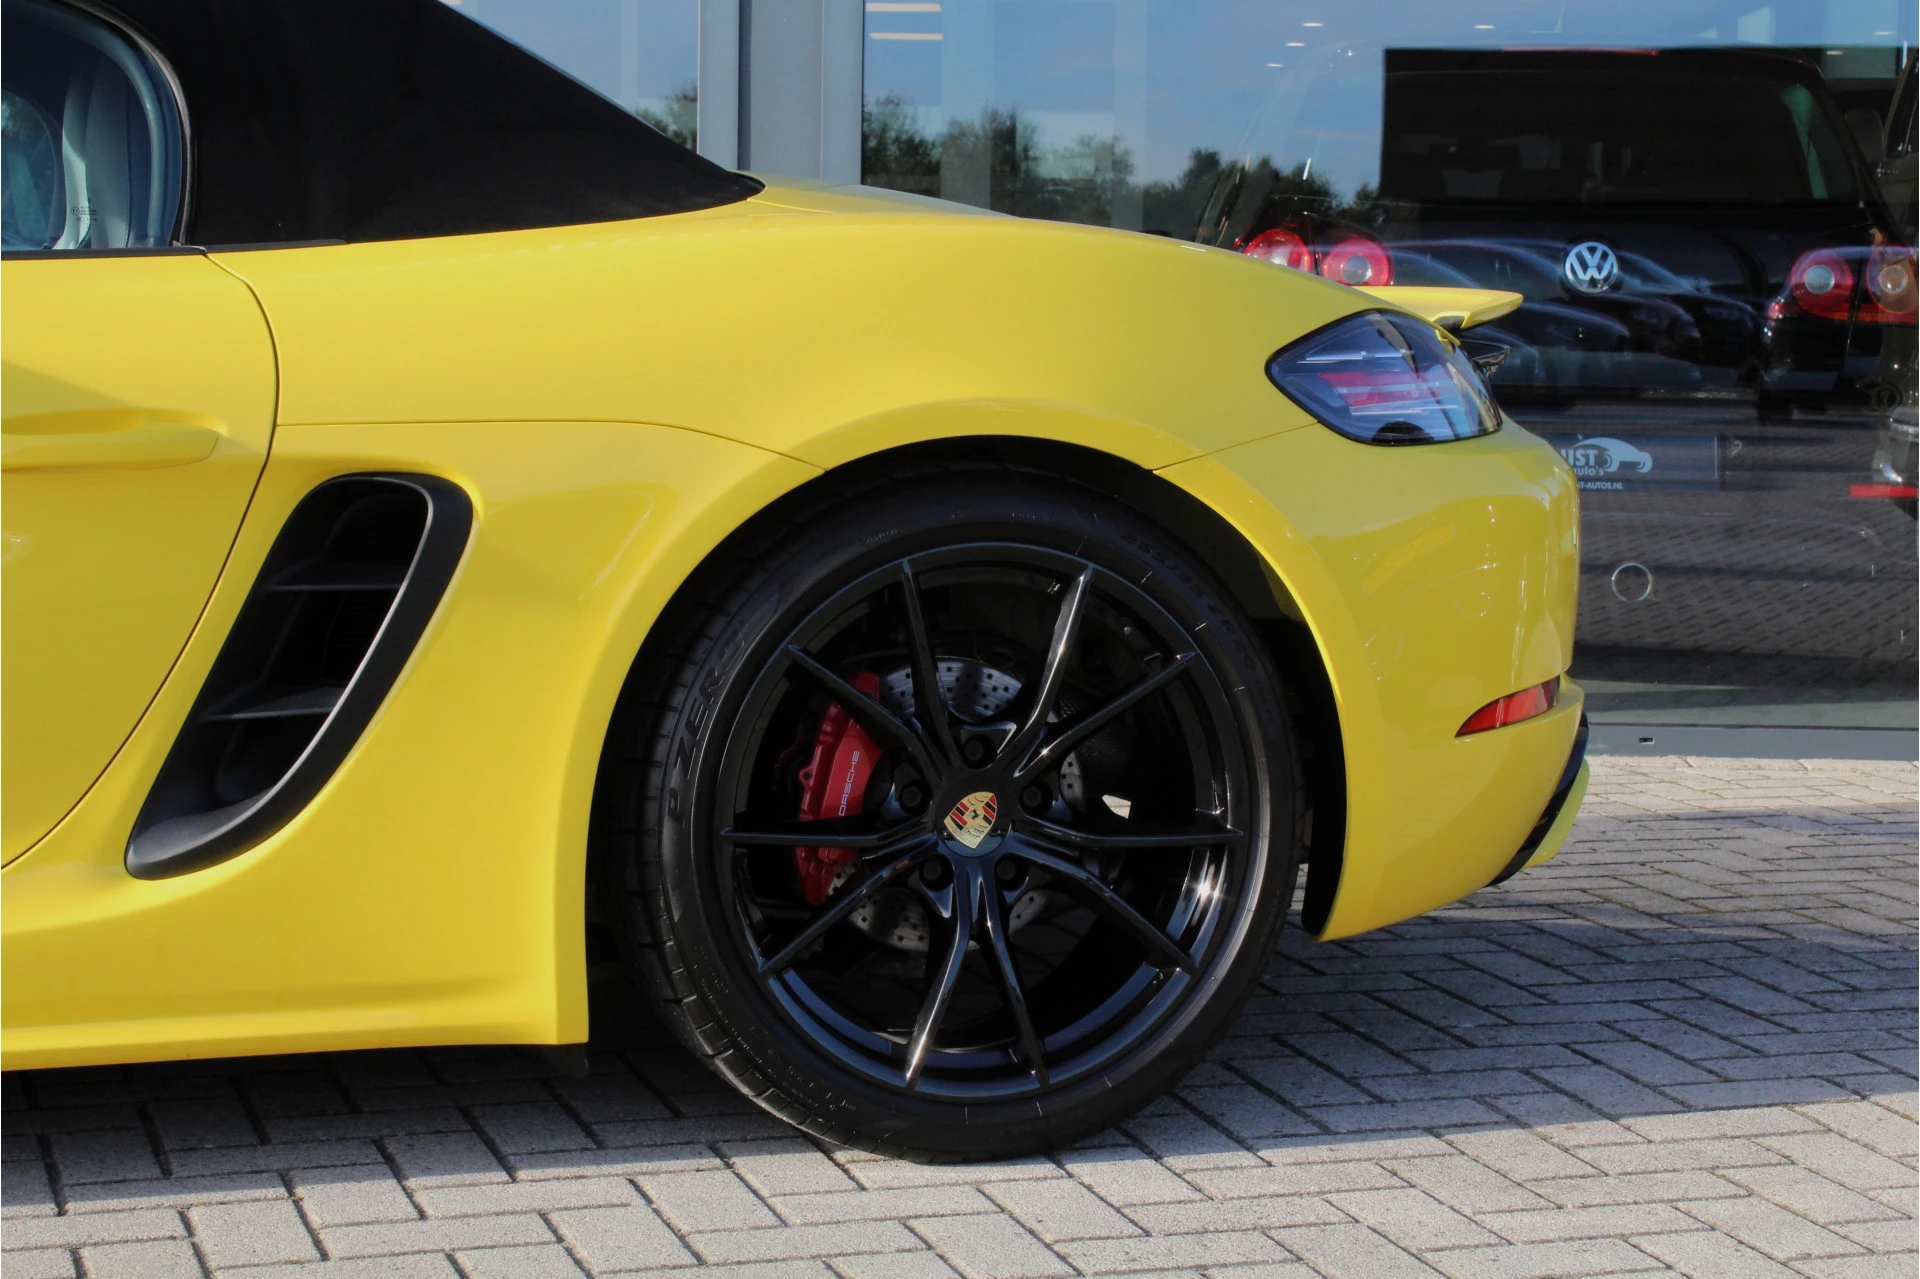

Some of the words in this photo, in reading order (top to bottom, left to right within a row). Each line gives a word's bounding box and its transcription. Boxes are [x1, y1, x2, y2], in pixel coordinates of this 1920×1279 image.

[1565, 241, 1619, 293] VW
[673, 629, 746, 780] ZERO
[838, 750, 860, 817] ORSCHE
